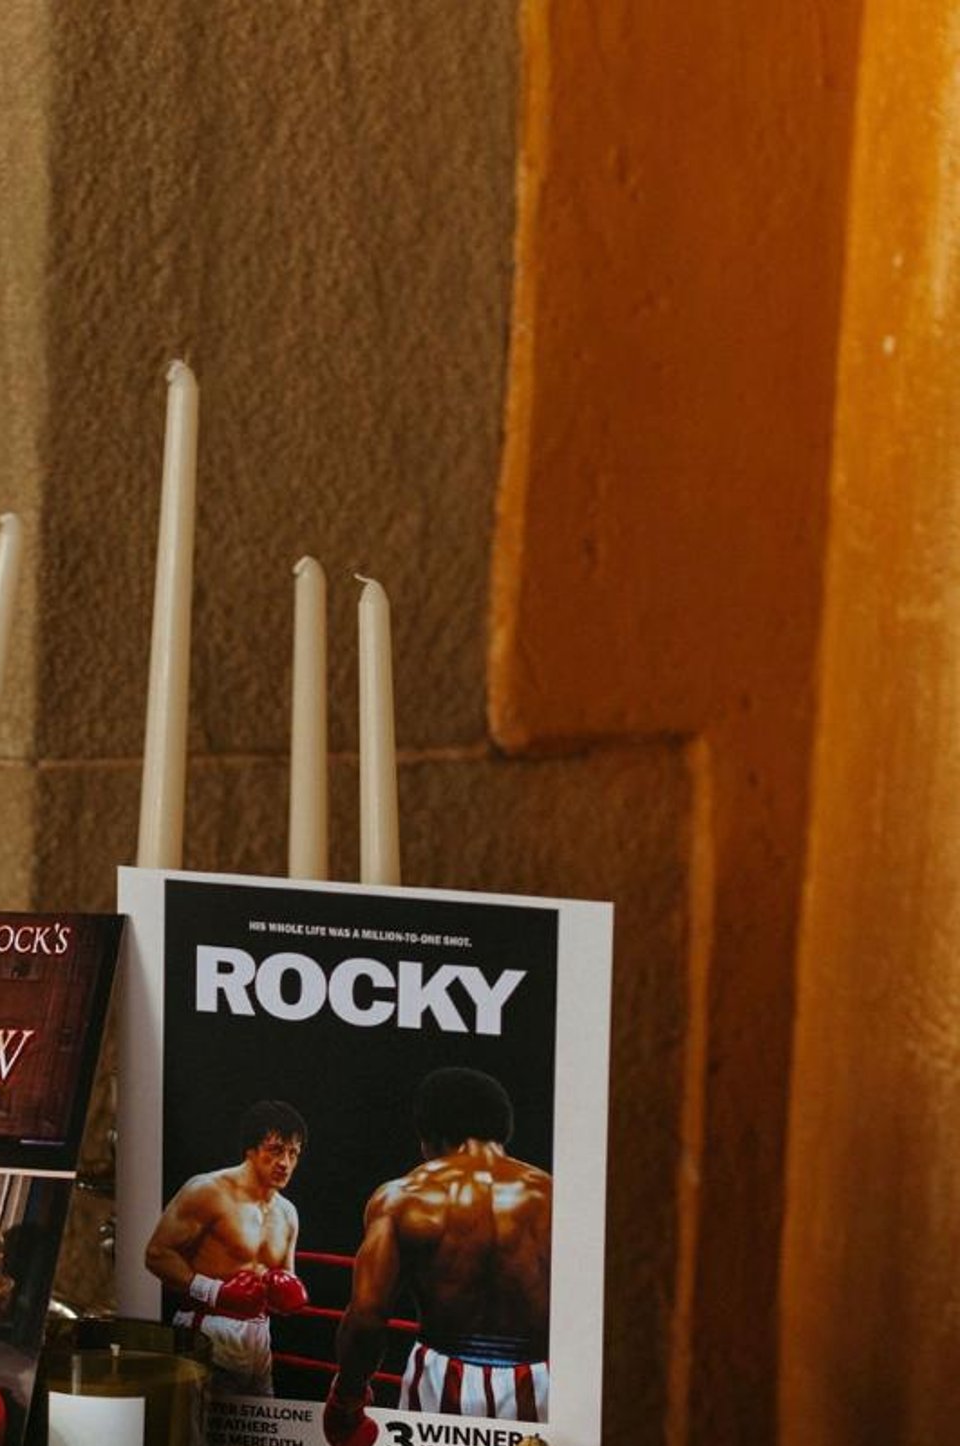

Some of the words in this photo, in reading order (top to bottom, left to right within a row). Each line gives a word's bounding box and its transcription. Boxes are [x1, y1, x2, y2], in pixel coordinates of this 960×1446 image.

[249, 920, 266, 932] HIS
[269, 922, 304, 935] WHOLE
[305, 924, 327, 936] LIFE
[328, 926, 351, 938] WAS
[352, 927, 360, 938] A
[196, 945, 527, 1035] ROCKY
[240, 1404, 314, 1422] STALLONE
